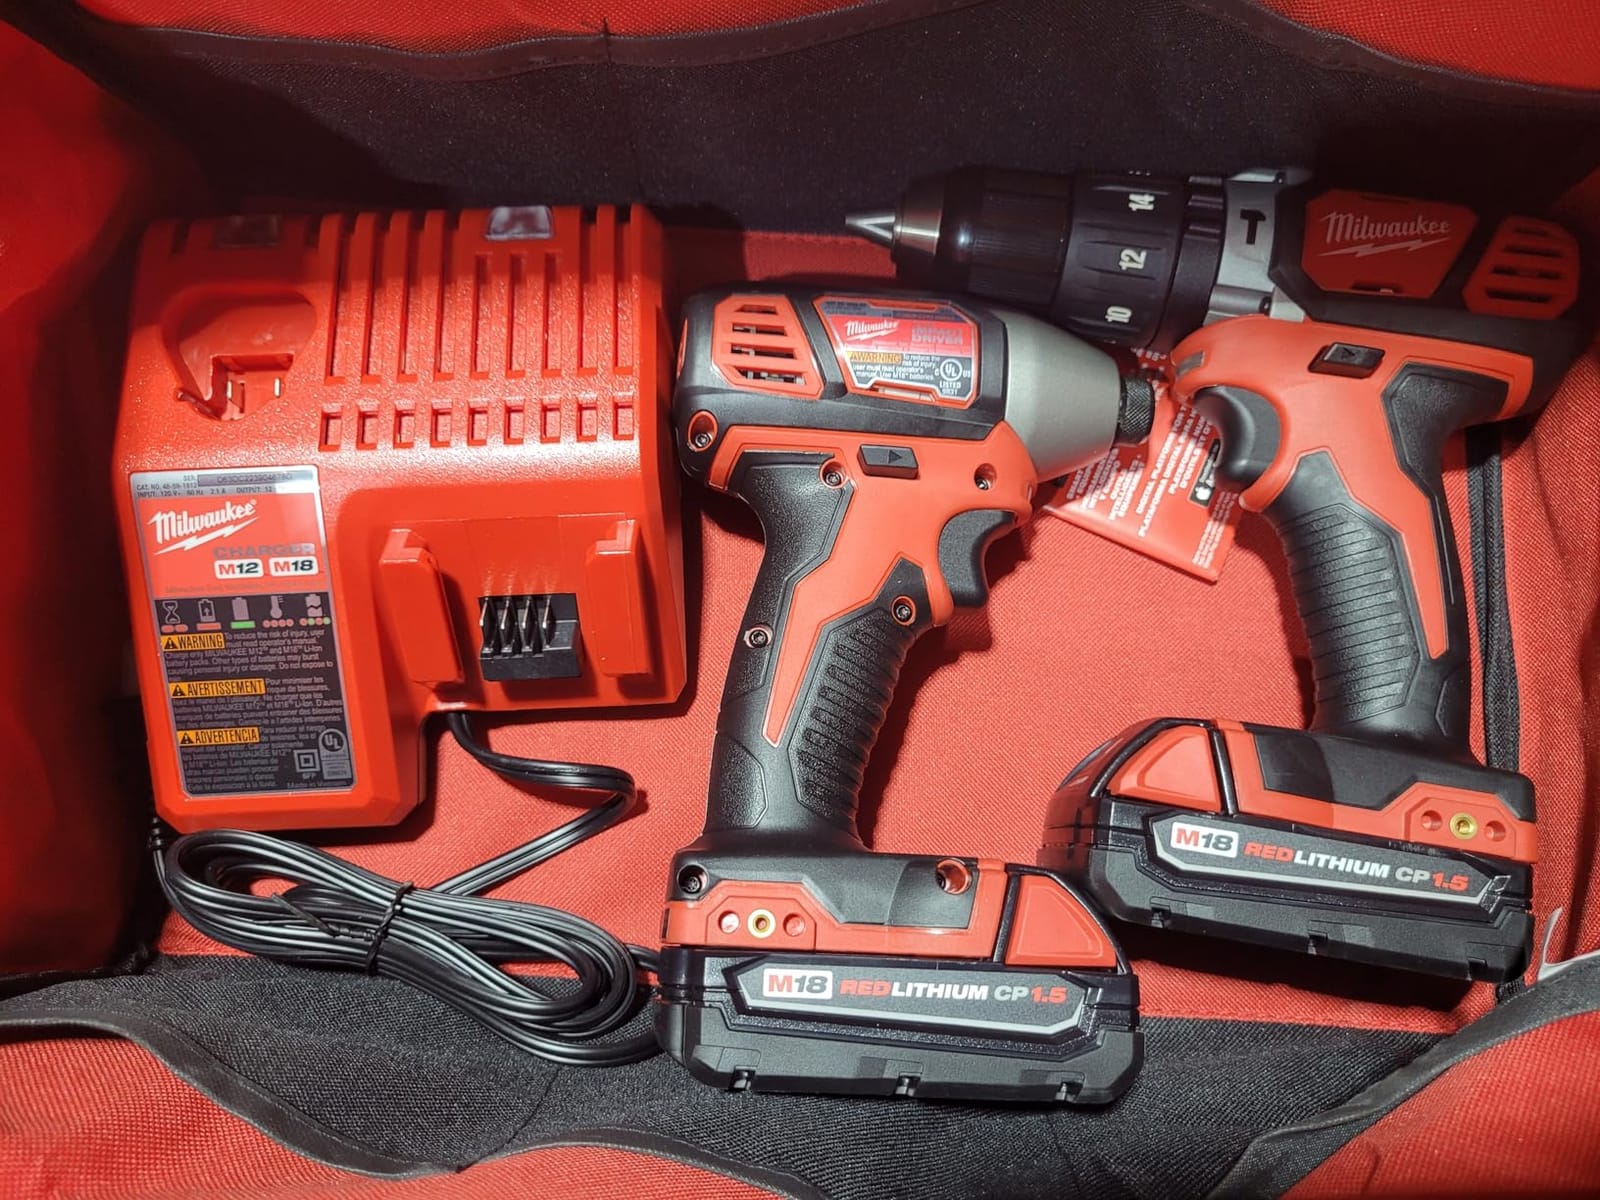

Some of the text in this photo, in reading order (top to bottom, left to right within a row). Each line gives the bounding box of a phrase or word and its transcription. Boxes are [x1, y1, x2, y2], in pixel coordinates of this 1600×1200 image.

[1128, 194, 1155, 211] 14
[1319, 211, 1450, 244] Milwaukee
[1119, 249, 1147, 270] 12
[1105, 306, 1132, 323] 10
[844, 320, 900, 337] Milwaukee
[147, 501, 256, 544] Milwaukee
[213, 543, 315, 559] CHARGER
[218, 559, 314, 575] M12 M18
[178, 634, 223, 649] WARNING
[187, 680, 263, 696] AVERTISSEMENT
[195, 728, 258, 744] ADVERTENCIA
[1175, 827, 1233, 851] M18
[1244, 840, 1390, 879] REDLITHIUM
[767, 974, 828, 994] M18
[839, 979, 989, 1001] REDLITHIUM
